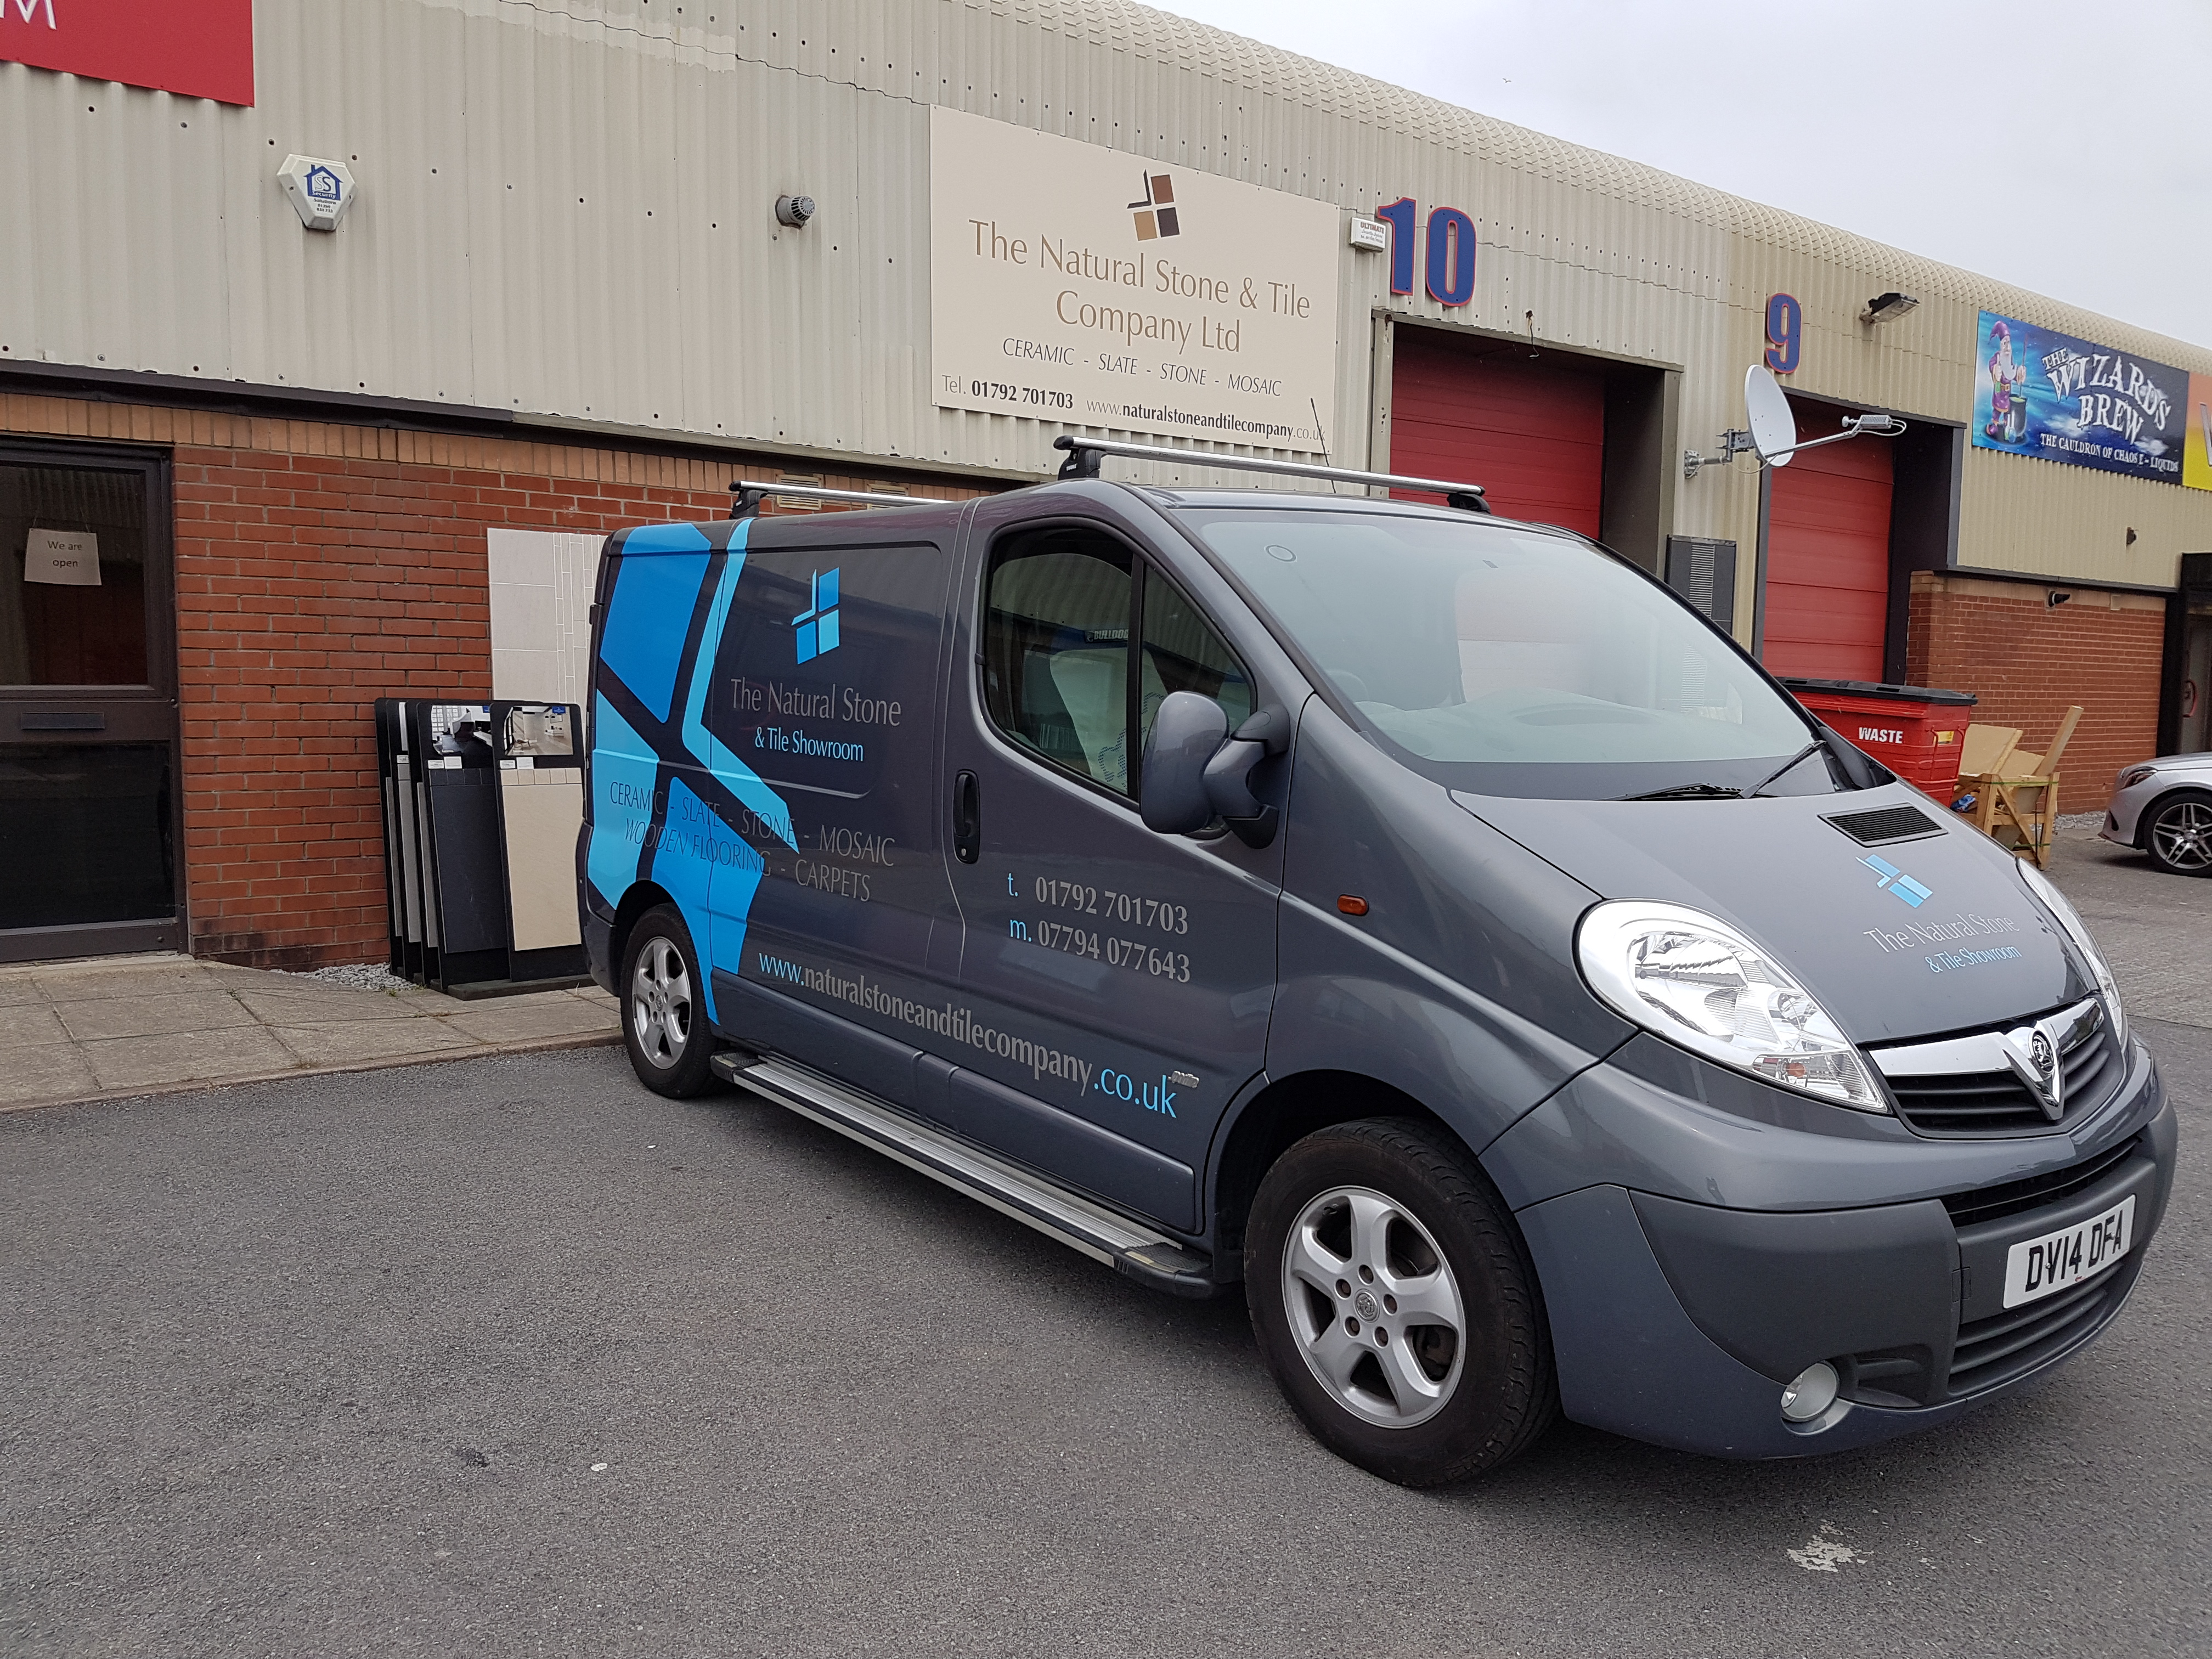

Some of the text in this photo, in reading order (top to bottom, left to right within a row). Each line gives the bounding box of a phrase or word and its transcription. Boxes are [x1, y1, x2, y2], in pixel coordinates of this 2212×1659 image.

[968, 219, 1311, 318] The Natural Stone & Tile
[1377, 196, 1476, 307] 10
[1057, 290, 1240, 356] Company Ltd
[1764, 292, 1802, 374] 9
[1003, 338, 1075, 365] CERAMIC
[1098, 353, 1138, 375] SLATE
[1160, 363, 1207, 385] STONE
[1228, 373, 1282, 397] MOSAIC
[2042, 347, 2068, 370] THE
[941, 374, 1074, 409] Tel. 01792 701703
[2046, 353, 2172, 431] WIZARDS
[2076, 393, 2145, 445] BREW
[1086, 399, 1325, 442] www.naturalstoneandtilecompany.co.uk
[2040, 433, 2057, 447] THE
[2058, 437, 2101, 457] CAULDRON
[2102, 446, 2113, 459] OF
[2114, 449, 2137, 465] CHAOS
[47, 540, 65, 549] We
[52, 560, 78, 568] open
[731, 676, 901, 726] The Natural Stone
[754, 726, 864, 761] & Tile Showroom
[1858, 726, 1903, 744] WASTE
[610, 781, 664, 815] CERAMIC
[681, 796, 720, 828] SLATE
[741, 808, 795, 844] STONE
[820, 824, 895, 867] MOSAIC
[624, 817, 687, 856] WOODEN
[692, 834, 771, 877] FLOORING
[795, 859, 871, 902] CARPETS
[1007, 872, 1188, 935] t. 01792 701703
[1010, 919, 1190, 983] m. 07794 077643
[1863, 913, 2020, 952] The Natural Stone
[1925, 946, 2023, 973] & Tile Showroom
[758, 952, 1177, 1118] www.naturalstoneandtilecompany.co.uk
[2025, 1209, 2123, 1293] DV14 DFA
